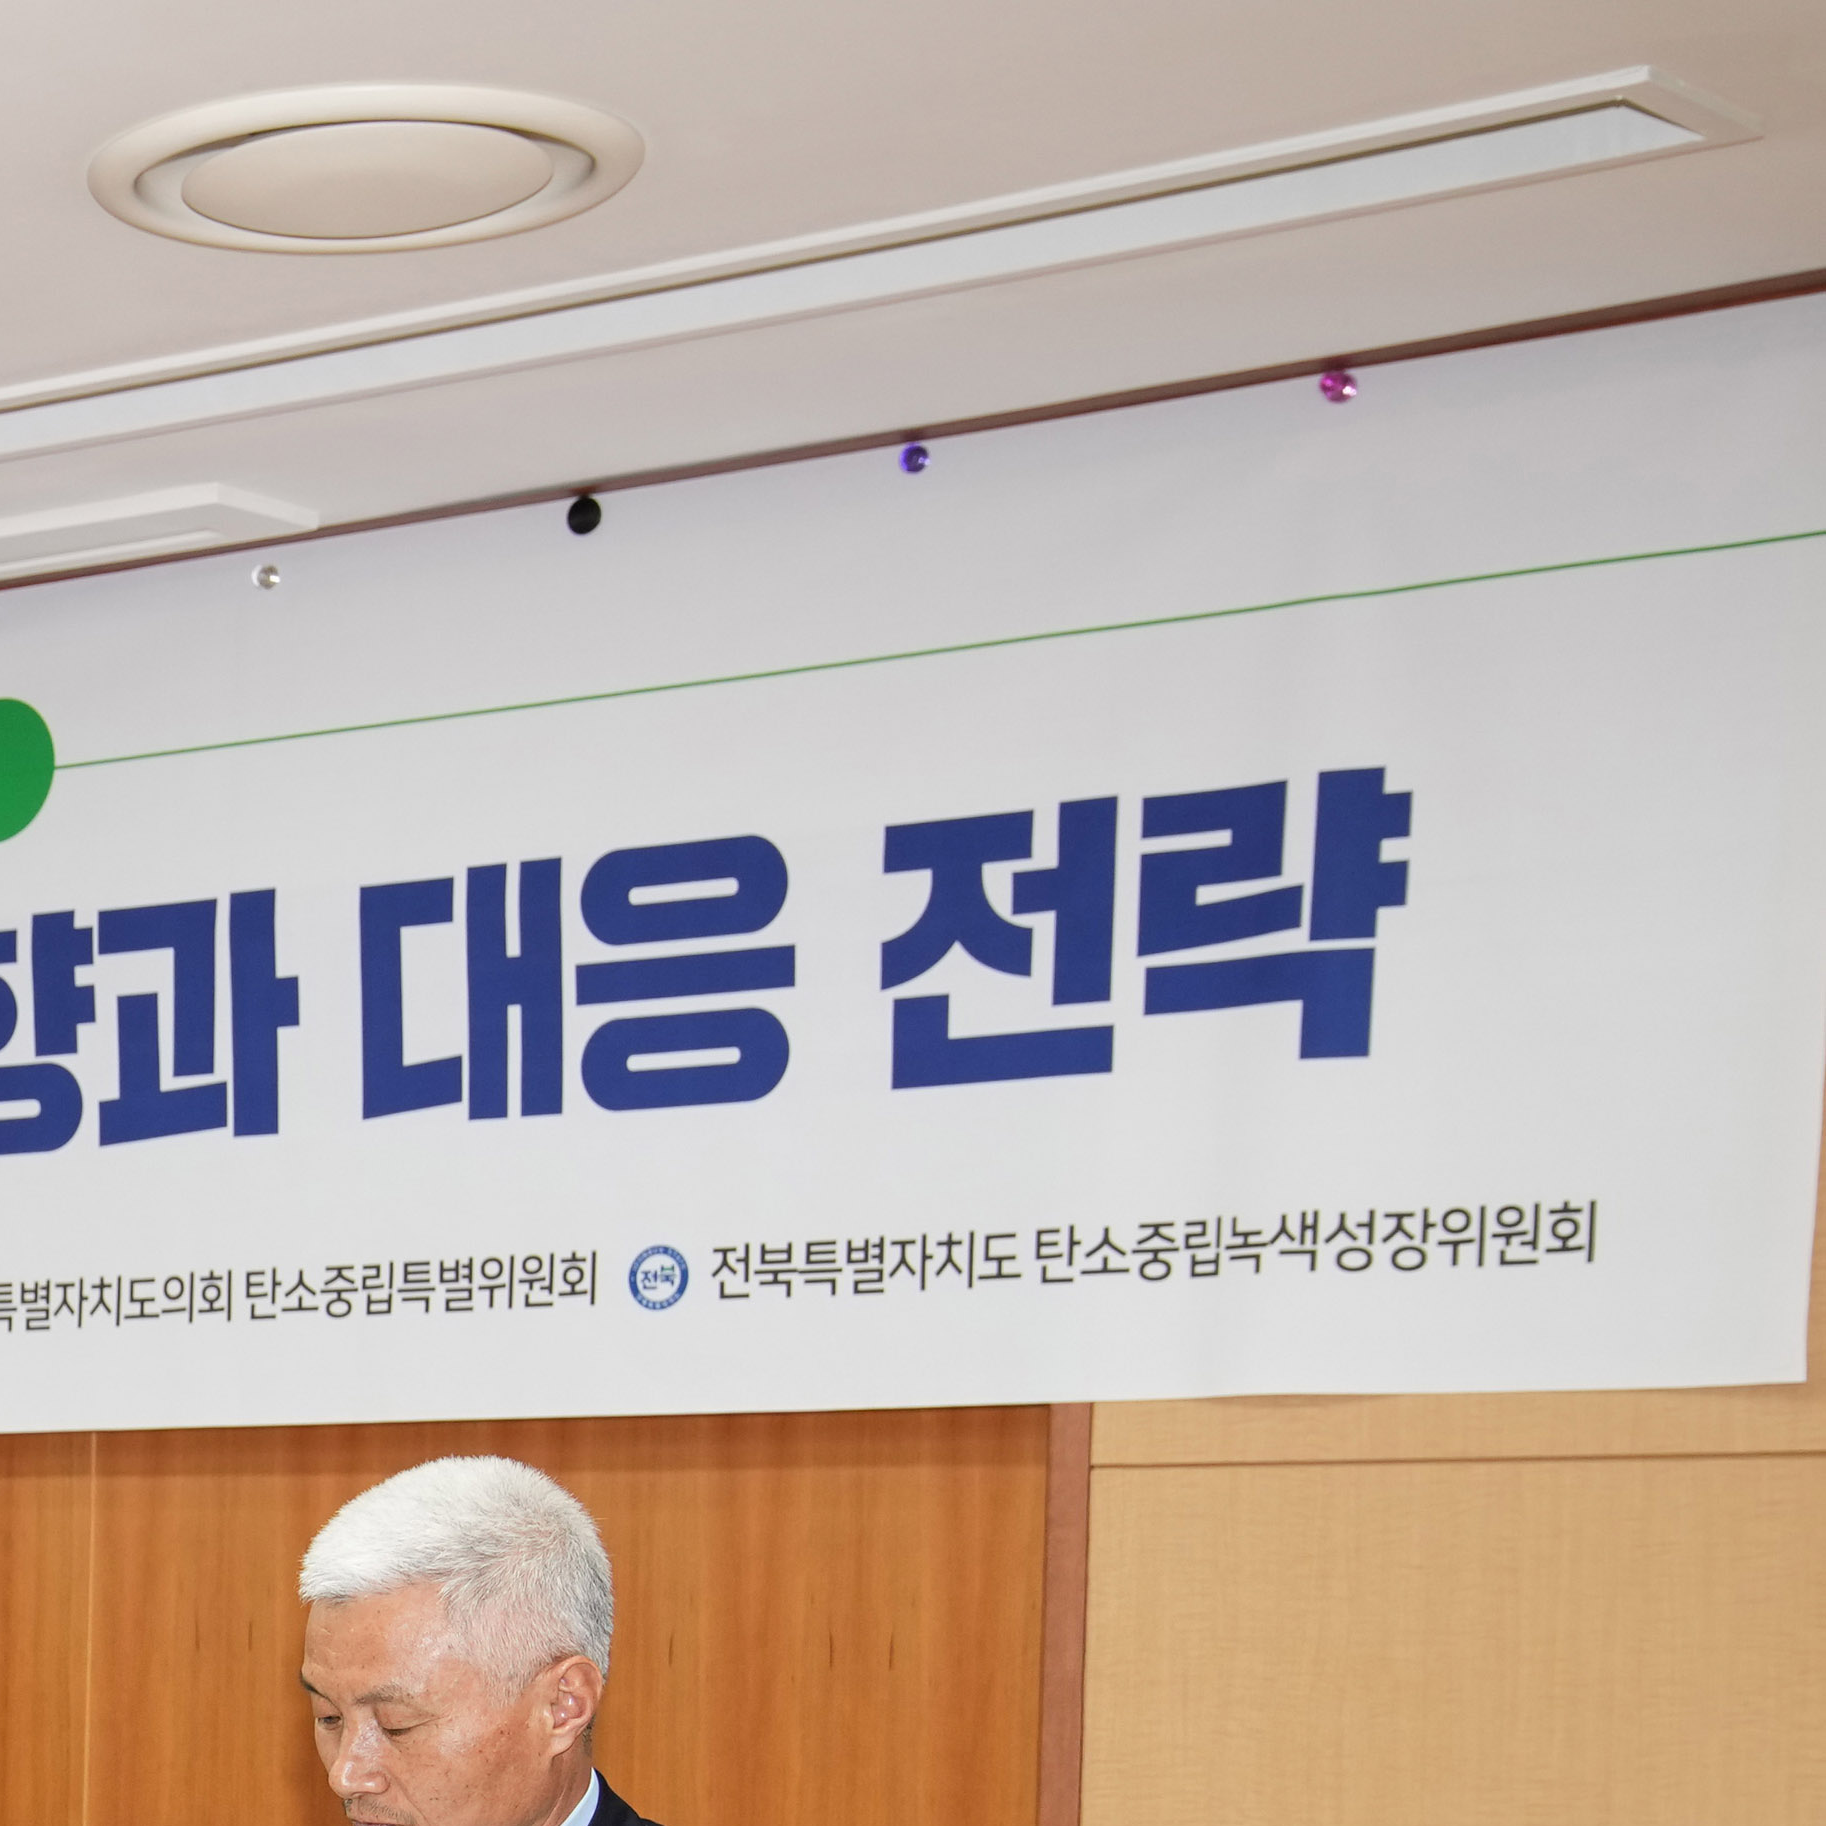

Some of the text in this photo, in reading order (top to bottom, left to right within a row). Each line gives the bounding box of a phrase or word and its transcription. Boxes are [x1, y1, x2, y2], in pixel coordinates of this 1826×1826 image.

[359, 836, 795, 1120] 대응
[881, 768, 1411, 1090] 전략
[246, 1250, 596, 1320] 탄소중립특별위원회
[712, 1230, 1022, 1299] 전북특별자치도
[1035, 1200, 1597, 1284] 탄소중립녹색성장위원회
